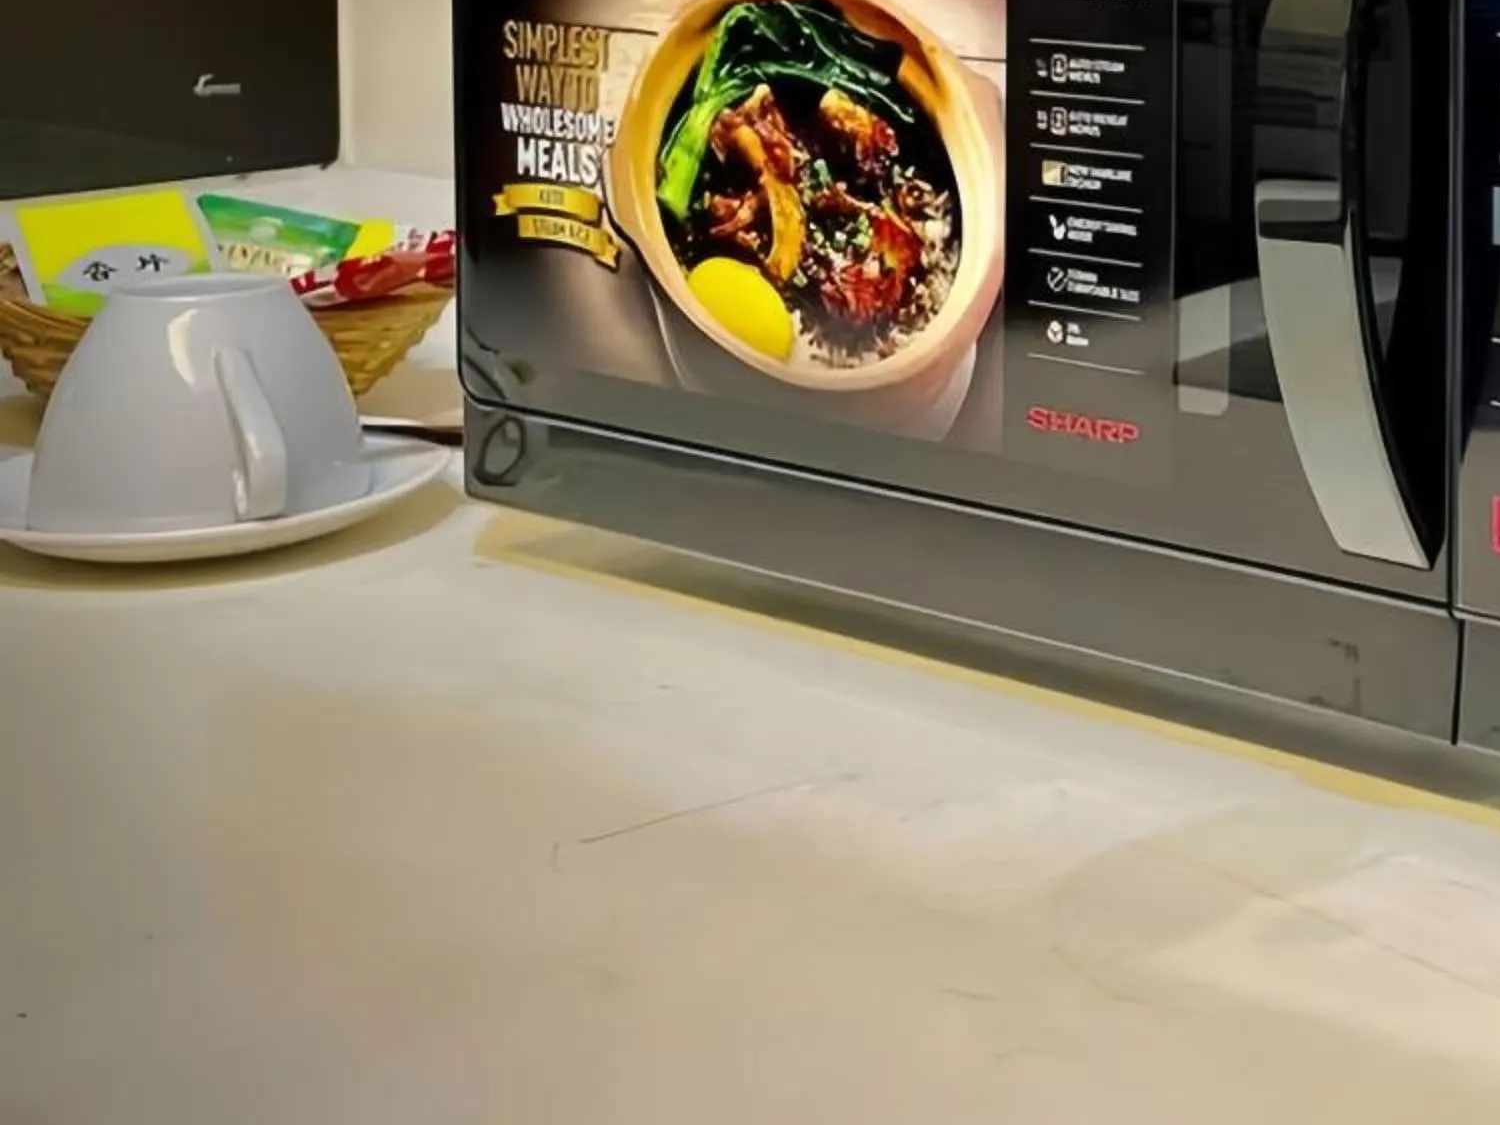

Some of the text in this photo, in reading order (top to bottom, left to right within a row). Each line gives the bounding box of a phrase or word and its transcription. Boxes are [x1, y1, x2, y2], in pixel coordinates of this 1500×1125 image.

[503, 19, 612, 72] SIMPLEST
[500, 102, 615, 144] WHOLESOME
[517, 137, 599, 184] MEALS
[1027, 405, 1140, 443] SHARP
